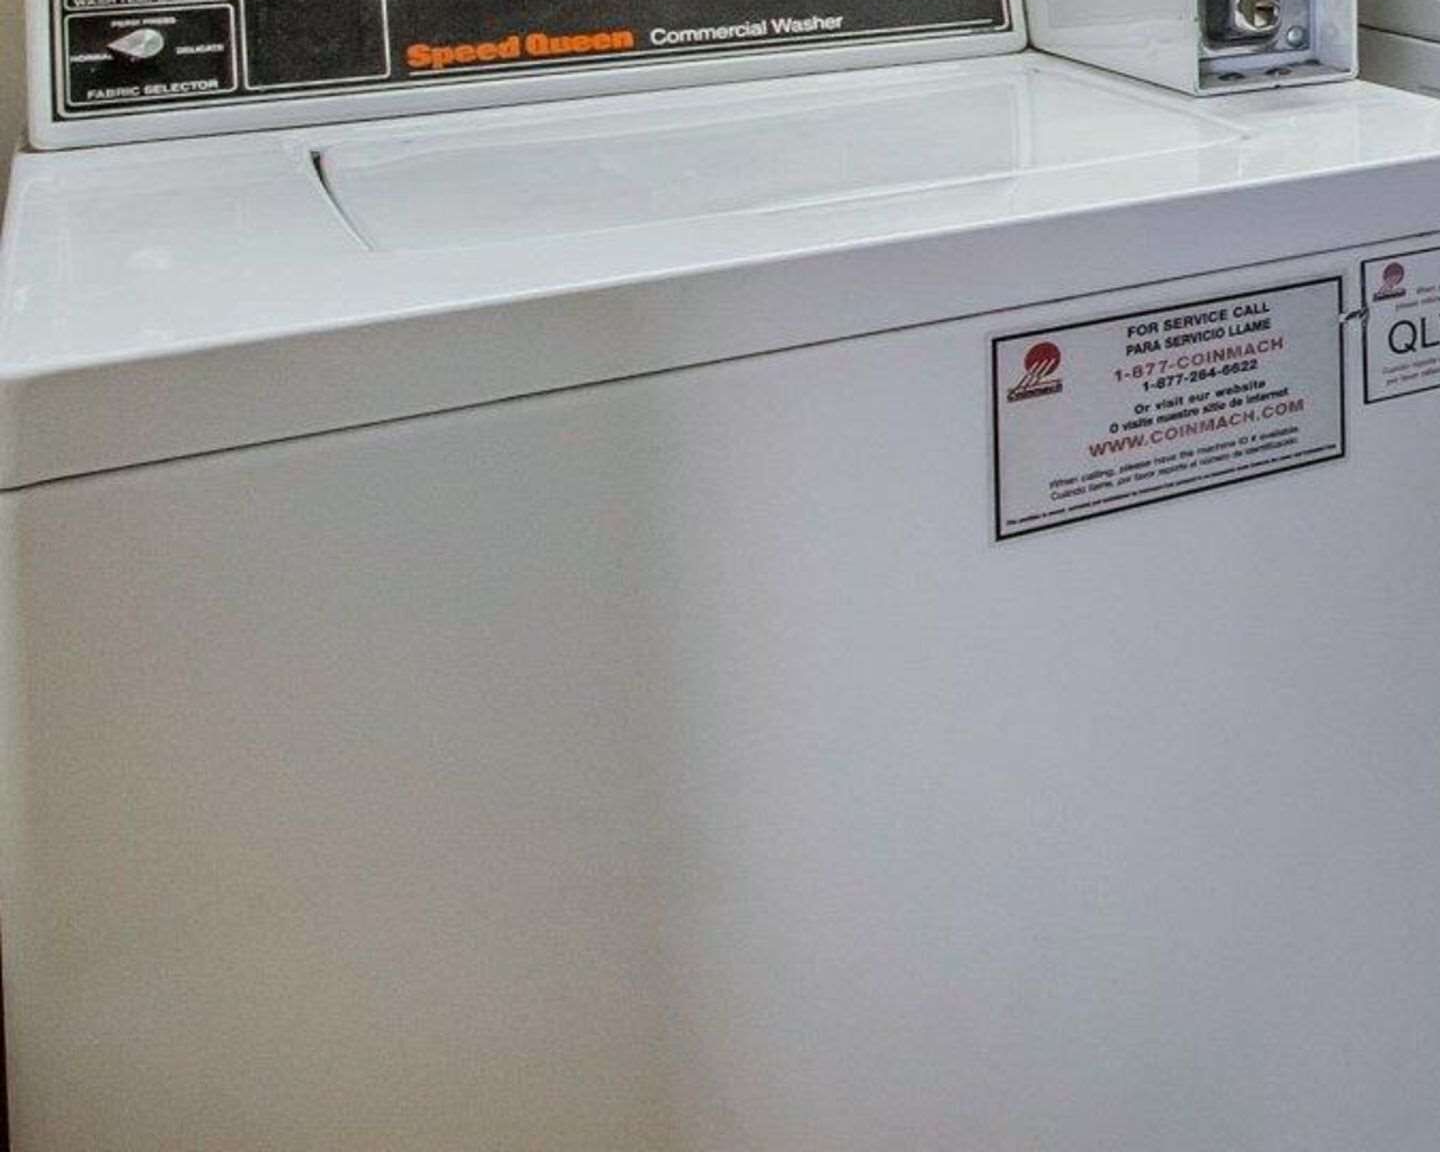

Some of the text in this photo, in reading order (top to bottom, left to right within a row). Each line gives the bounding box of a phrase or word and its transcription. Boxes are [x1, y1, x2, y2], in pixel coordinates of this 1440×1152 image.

[406, 14, 844, 69] Speed Queen Commercial Washer
[86, 79, 219, 100] FABRIC SELECTOR
[1126, 317, 1271, 356] PARA SERVICIO LLAME
[1127, 301, 1270, 339] FOR SERVICE CALL
[1114, 336, 1285, 383] 1-877-COINMACH
[1109, 422, 1119, 434] O
[1229, 397, 1243, 409] de
[1133, 379, 1266, 415] Or visit our website
[1089, 398, 1305, 457] WWW.COINMACH.COM
